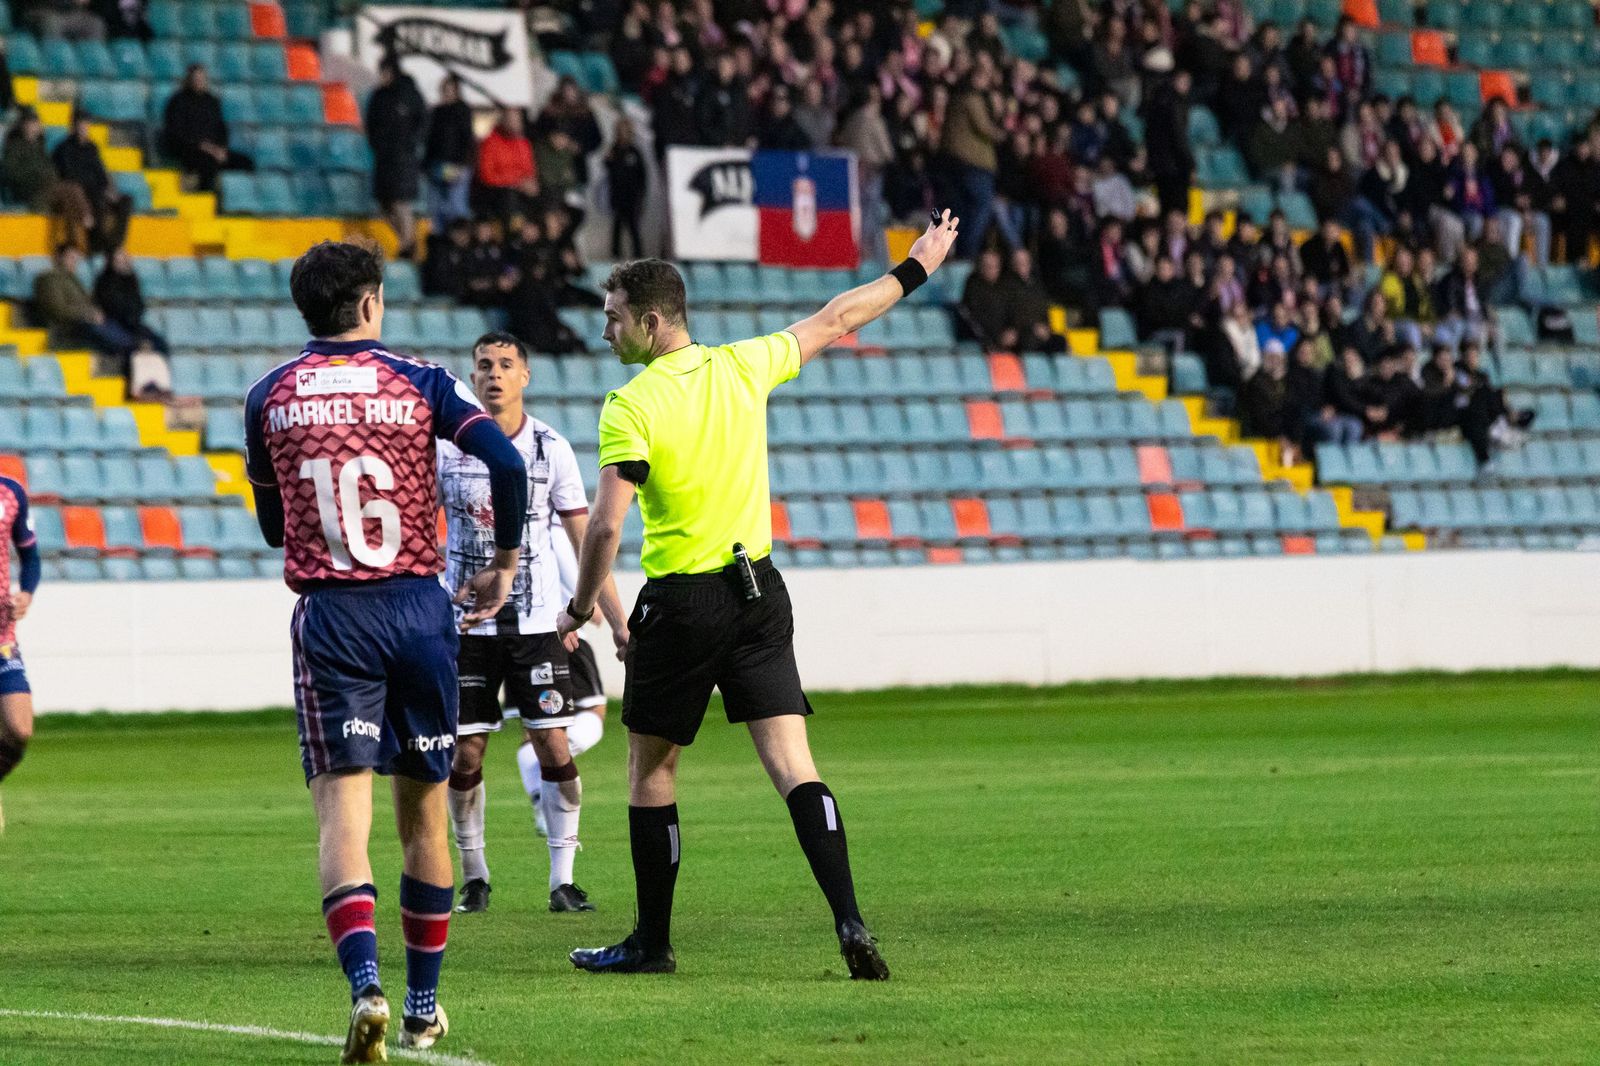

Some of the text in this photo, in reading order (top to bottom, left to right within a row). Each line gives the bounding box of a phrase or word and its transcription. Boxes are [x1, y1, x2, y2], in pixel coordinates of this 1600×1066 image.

[269, 399, 416, 432] MARKEL RUIZ
[300, 456, 401, 570] 16
